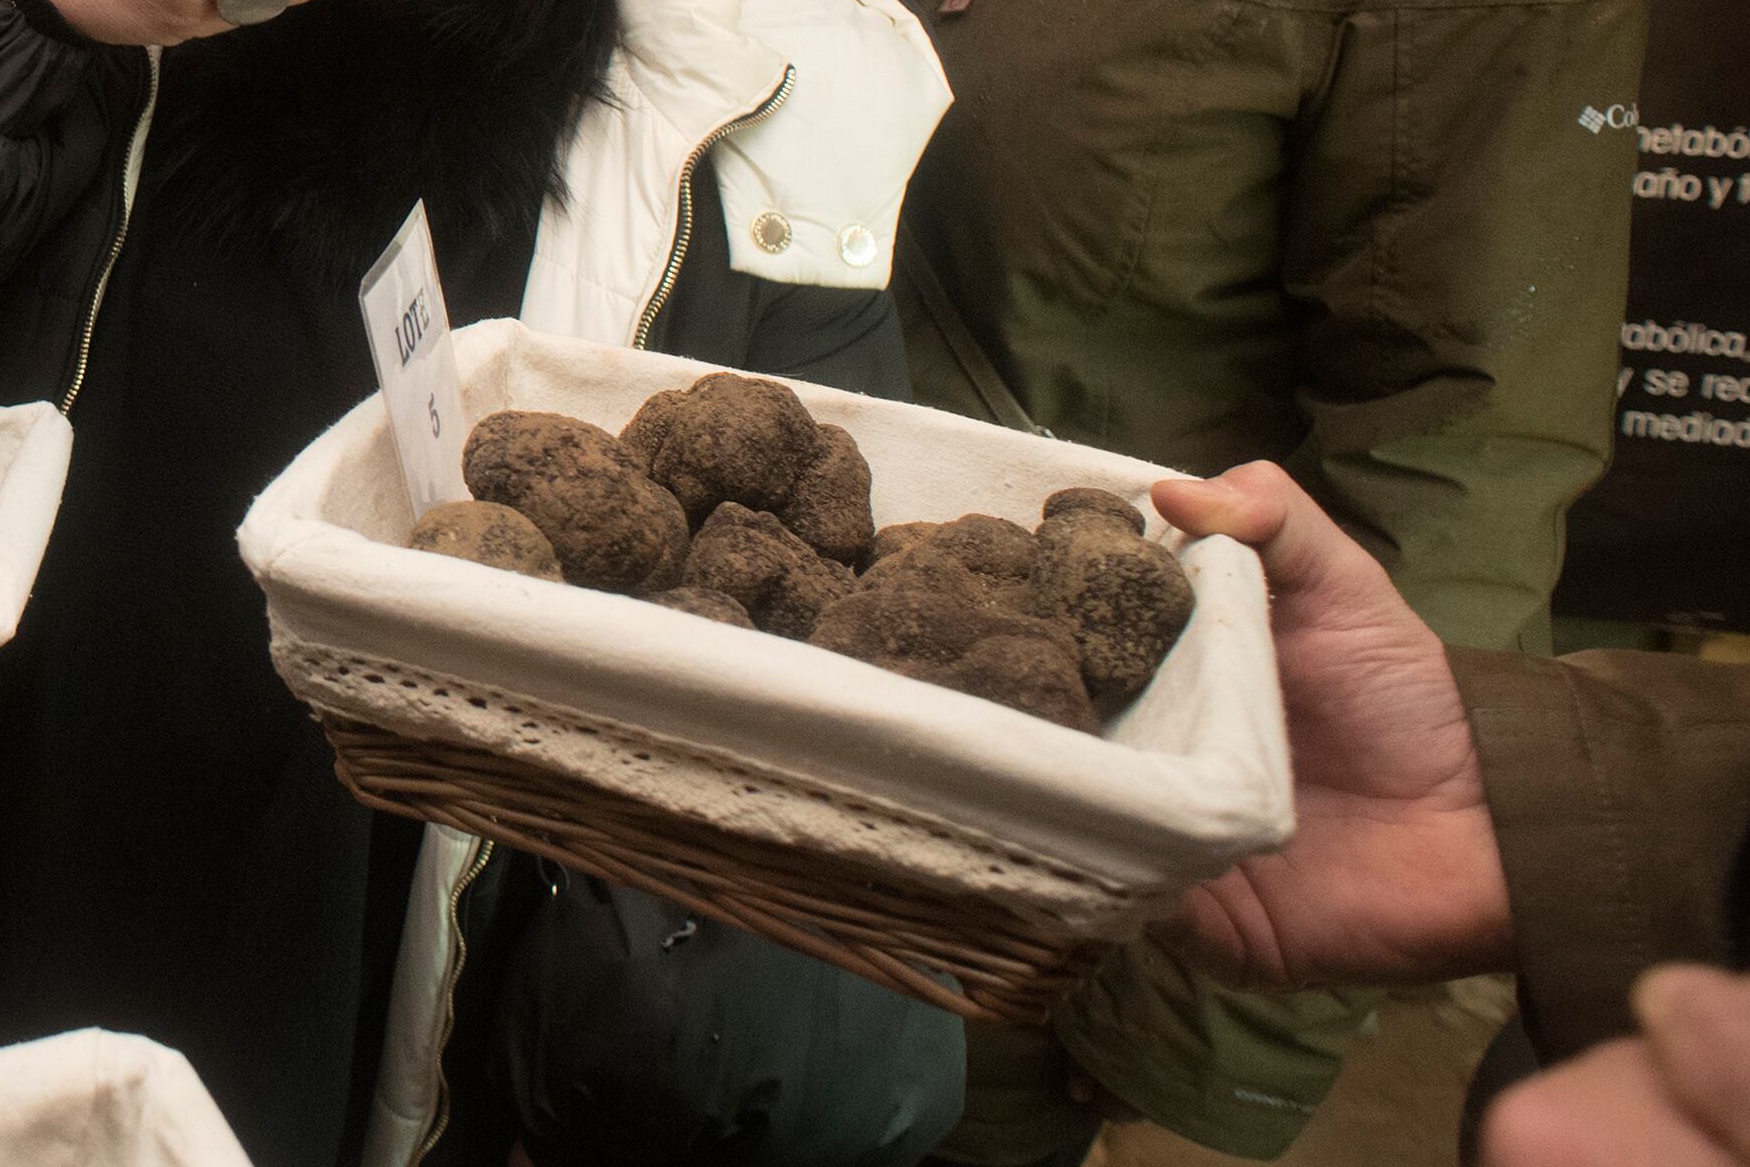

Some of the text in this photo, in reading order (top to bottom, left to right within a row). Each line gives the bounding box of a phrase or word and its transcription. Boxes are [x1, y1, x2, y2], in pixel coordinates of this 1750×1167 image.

[1708, 176, 1734, 210] y
[394, 288, 430, 368] LOTE
[1643, 369, 1690, 398] se
[427, 391, 441, 439] 5
